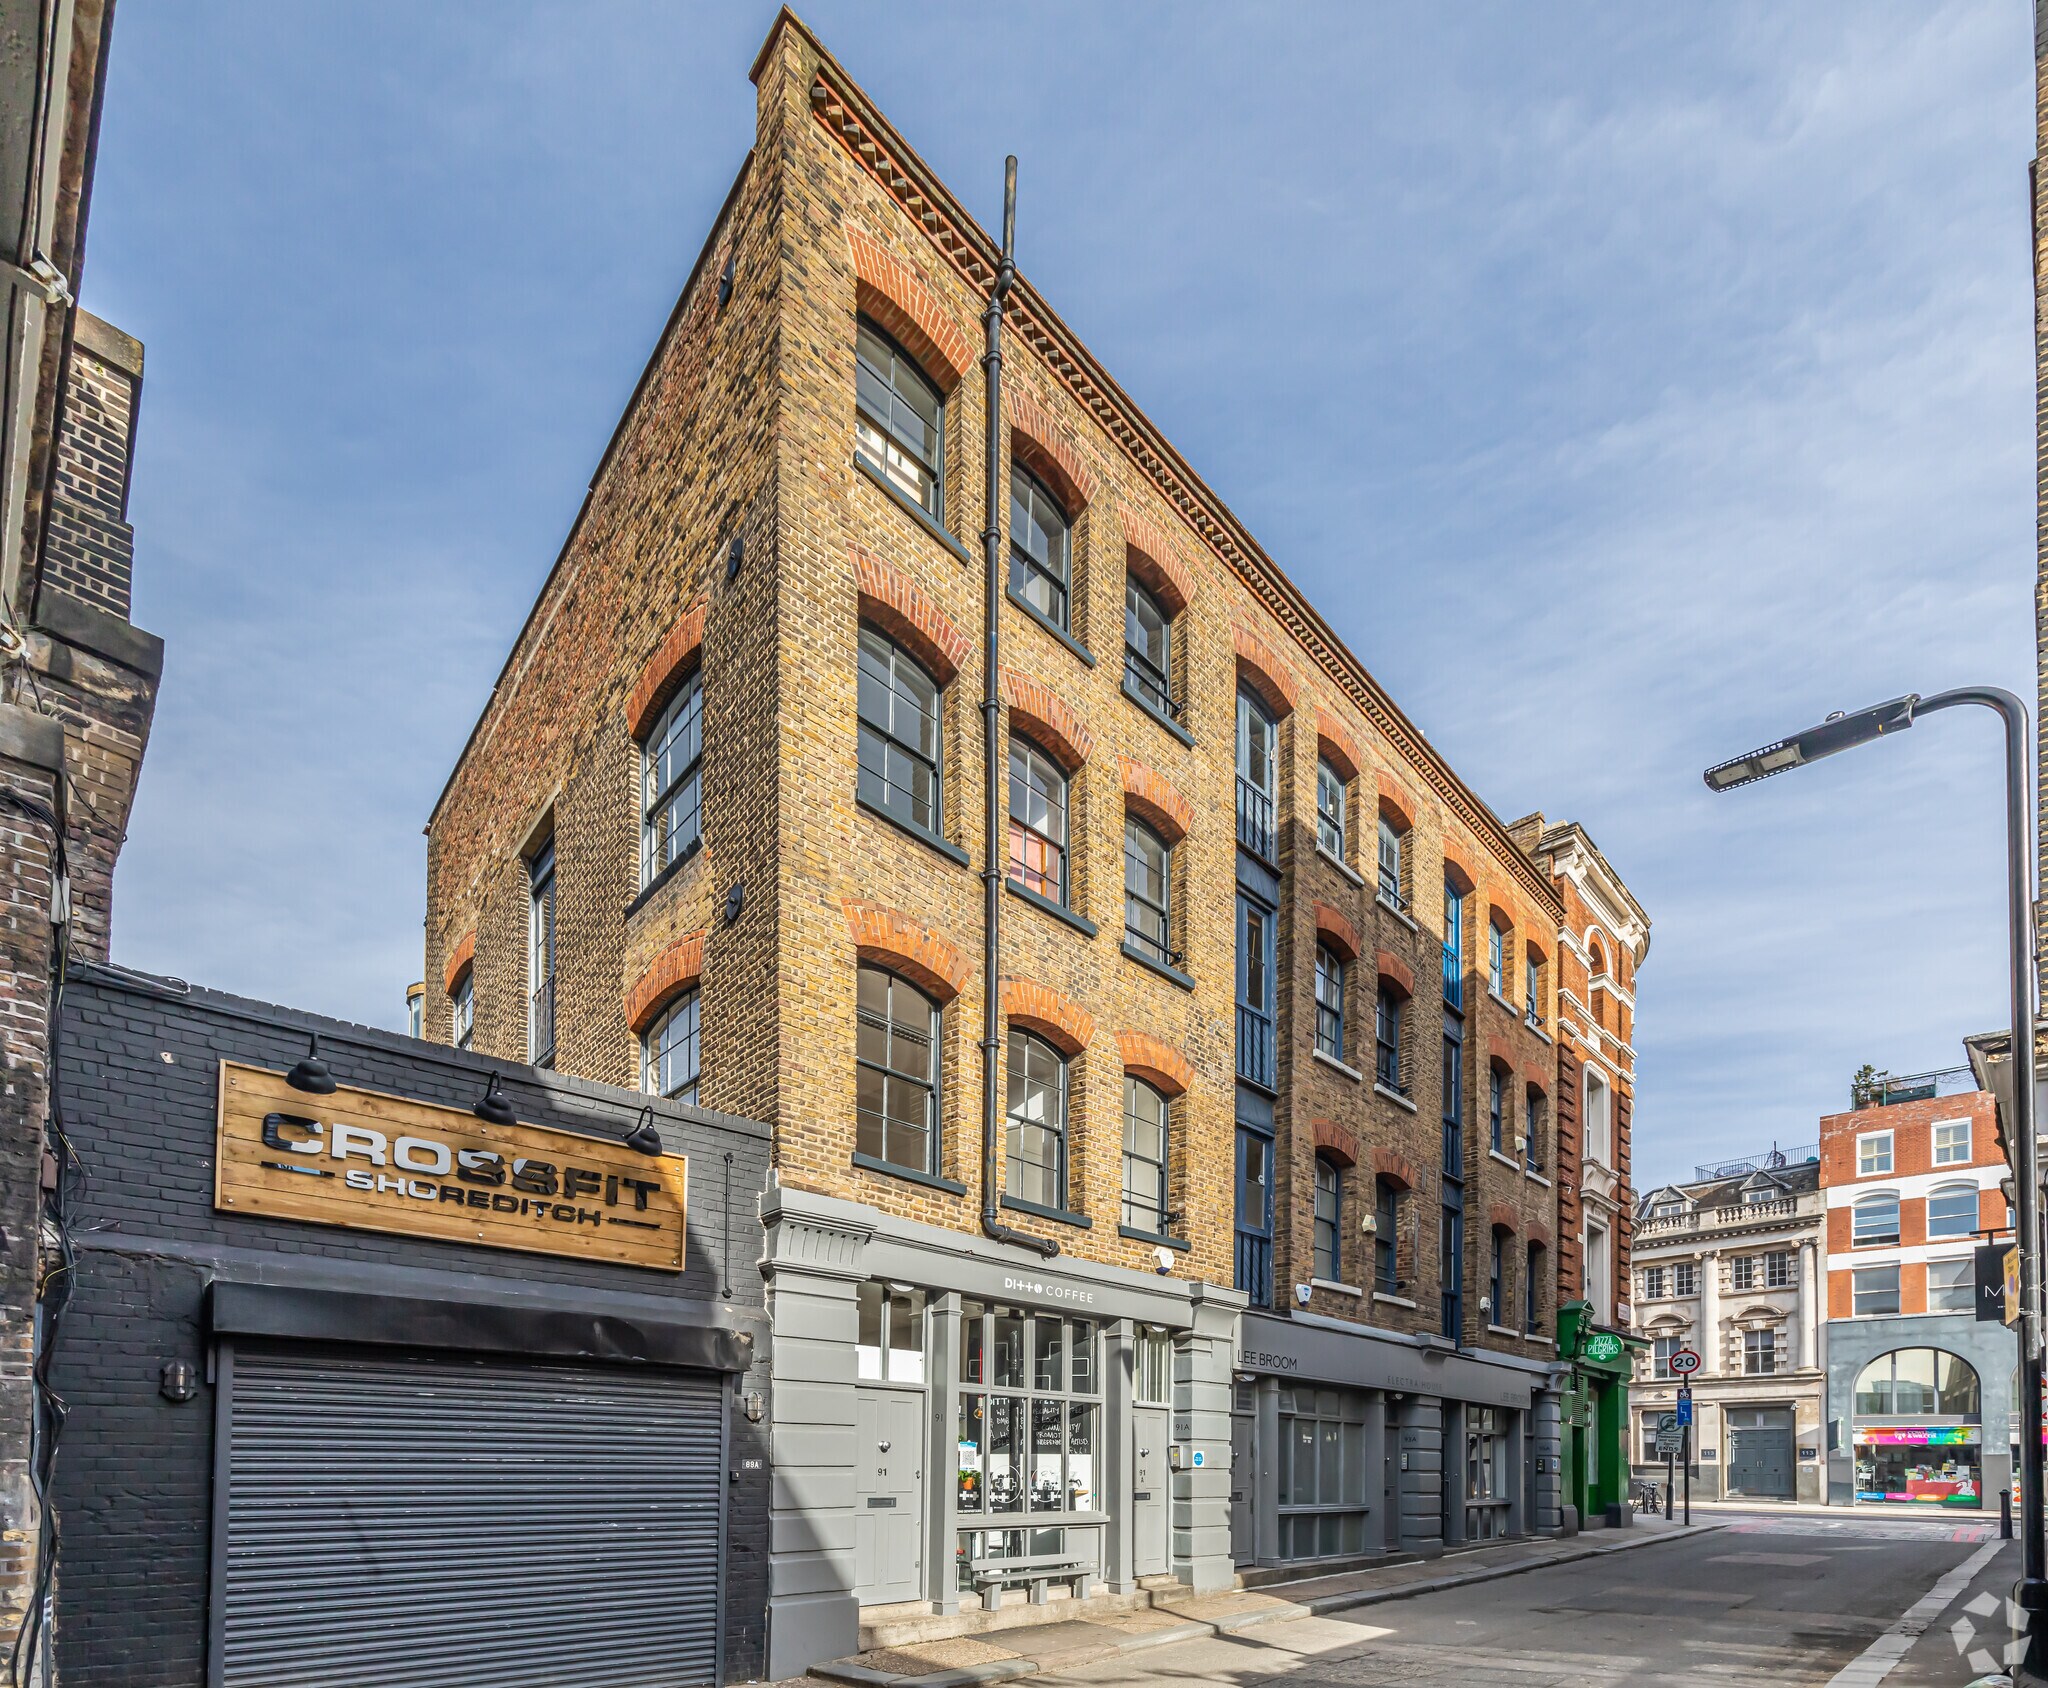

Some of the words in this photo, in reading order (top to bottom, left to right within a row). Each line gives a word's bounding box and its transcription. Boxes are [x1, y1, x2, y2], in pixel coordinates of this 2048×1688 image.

[261, 1112, 661, 1211] CROSSFIT
[345, 1169, 601, 1226] SHOREDITCH
[1046, 1285, 1094, 1303] COFFEE
[1594, 1336, 1612, 1345] PIZZA
[1587, 1344, 1619, 1354] PILGRIMS
[1237, 1349, 1257, 1365] LEE
[1259, 1353, 1297, 1371] BROOM
[1674, 1357, 1696, 1368] 20
[935, 1413, 943, 1422] 91
[1175, 1423, 1190, 1431] 91A
[877, 1467, 888, 1477] 91
